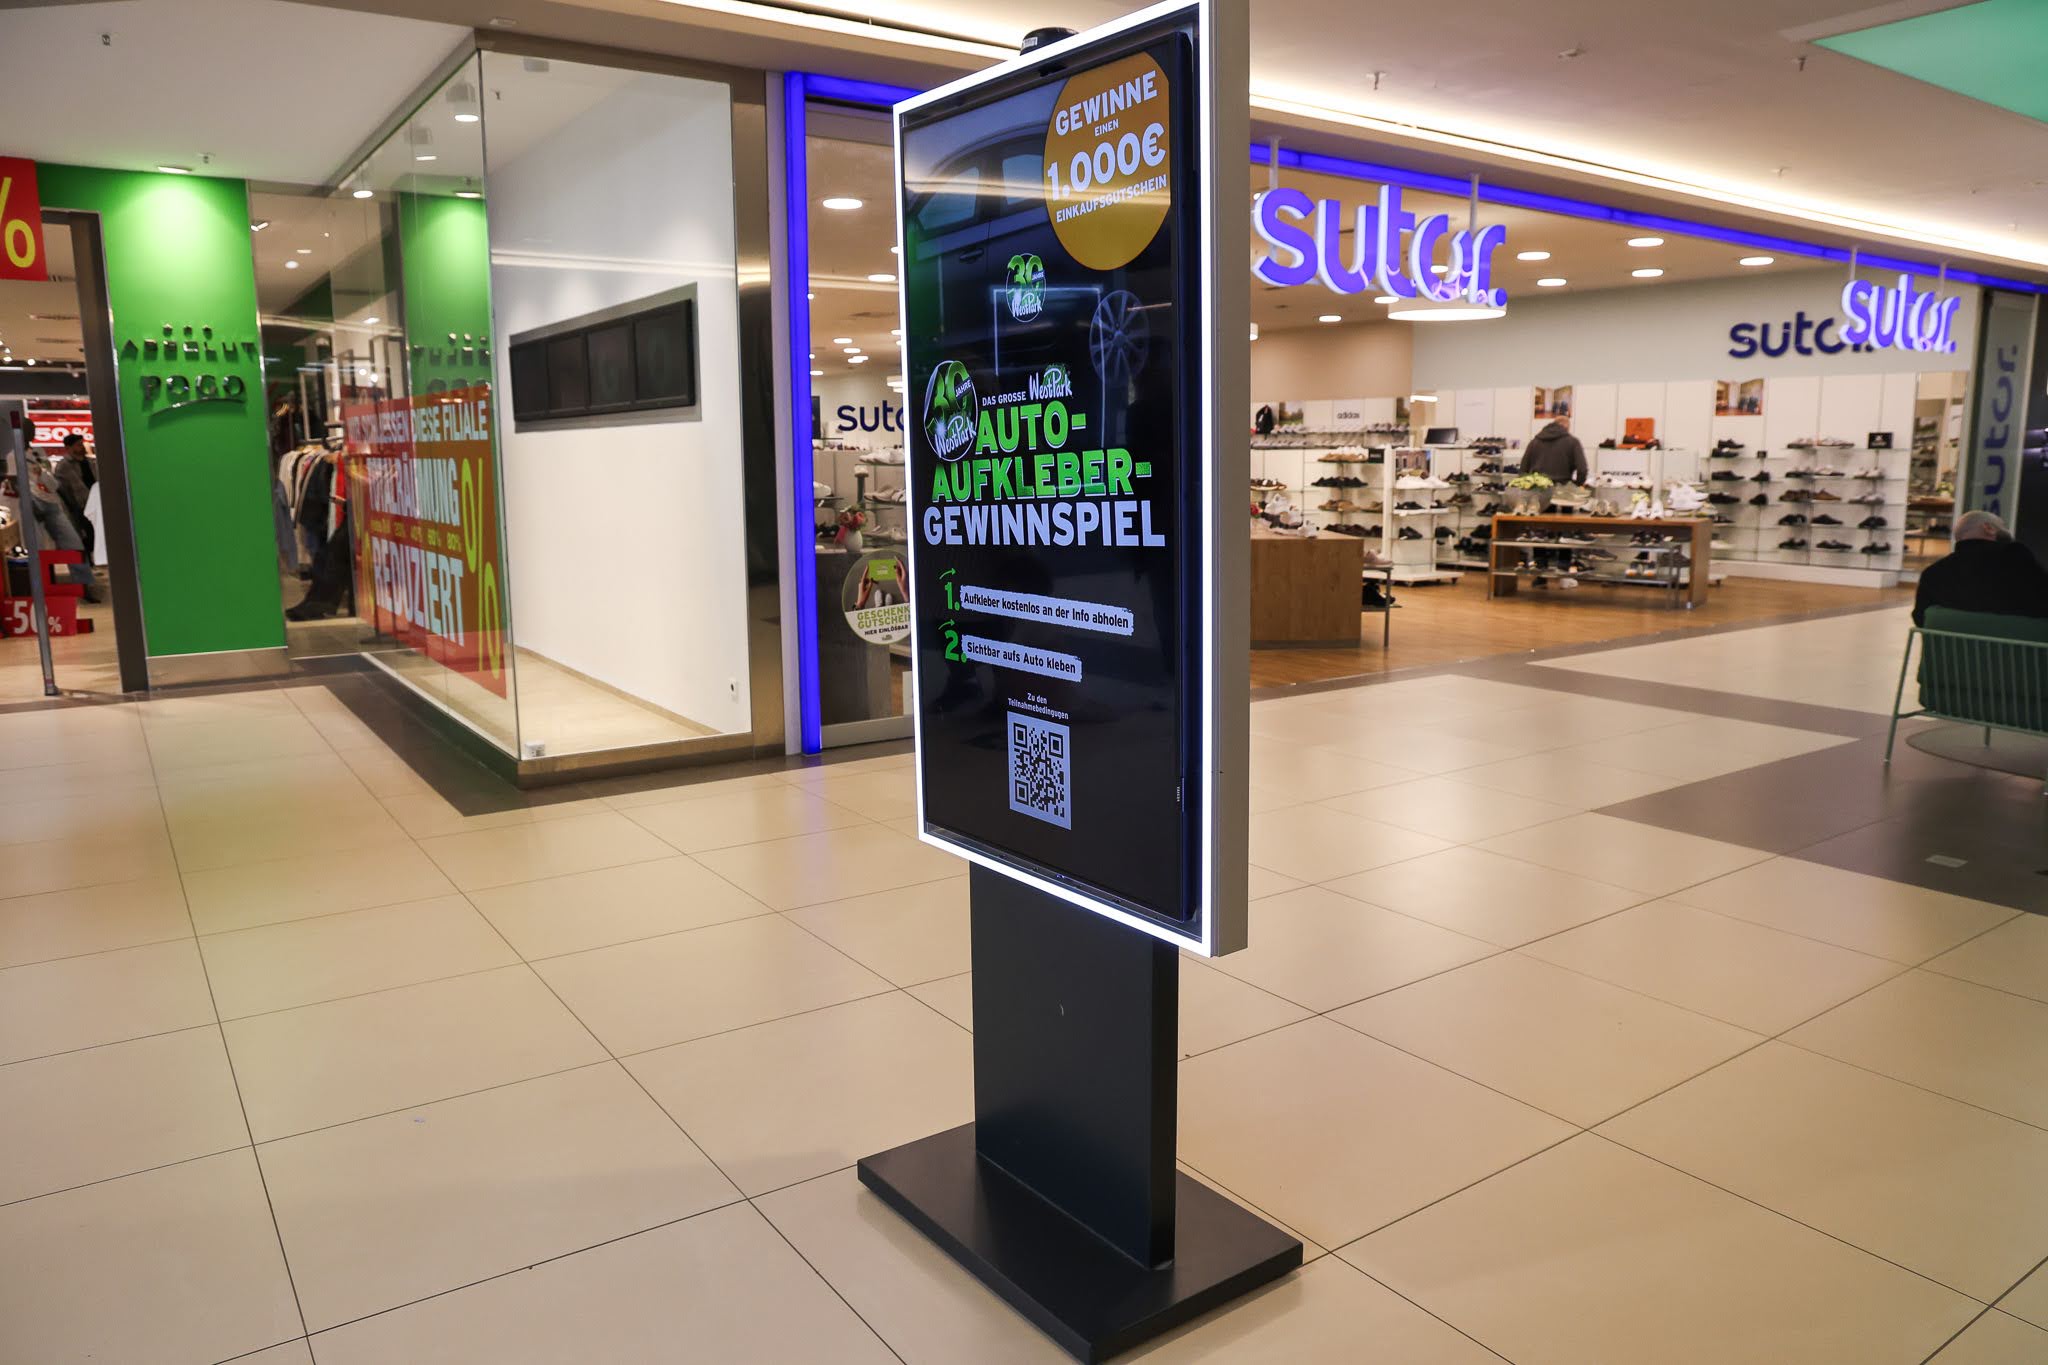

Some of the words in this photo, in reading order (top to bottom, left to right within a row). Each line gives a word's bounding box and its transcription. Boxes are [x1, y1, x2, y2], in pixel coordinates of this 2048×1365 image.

[1055, 70, 1158, 136] GEWINNE
[1094, 118, 1119, 137] EINEN
[1047, 122, 1166, 202] 1.000€
[1056, 174, 1167, 223] EINKAUFSGUTSCHEIN
[140, 375, 247, 411] POGO
[955, 379, 972, 398] JAHRE
[982, 396, 997, 407] DAS
[998, 391, 1027, 405] GROSSE
[1028, 366, 1073, 401] WestPark
[411, 406, 441, 442] DIESE
[442, 400, 488, 441] FILIALE
[934, 415, 977, 459] WestPark
[975, 400, 1087, 455] AUTO-
[932, 448, 1152, 503] AUFKLEBER-
[923, 500, 1166, 548] GEWINNSPIEL
[372, 536, 465, 647] REDUZIERT
[944, 581, 961, 611] 1.
[964, 592, 1000, 609] Aufkleber
[1002, 598, 1040, 615] kostenlos
[1042, 606, 1053, 617] an
[1055, 606, 1070, 619] der
[1072, 608, 1090, 623] Info
[1092, 612, 1129, 629] abholen
[864, 628, 877, 636] HIER
[944, 630, 967, 663] 2.
[967, 641, 1000, 658] Sichtbar
[1002, 649, 1021, 662] aufs
[1023, 654, 1044, 667] Auto
[1046, 656, 1076, 674] kleben
[1027, 692, 1036, 702] Zu
[1036, 695, 1048, 704] den
